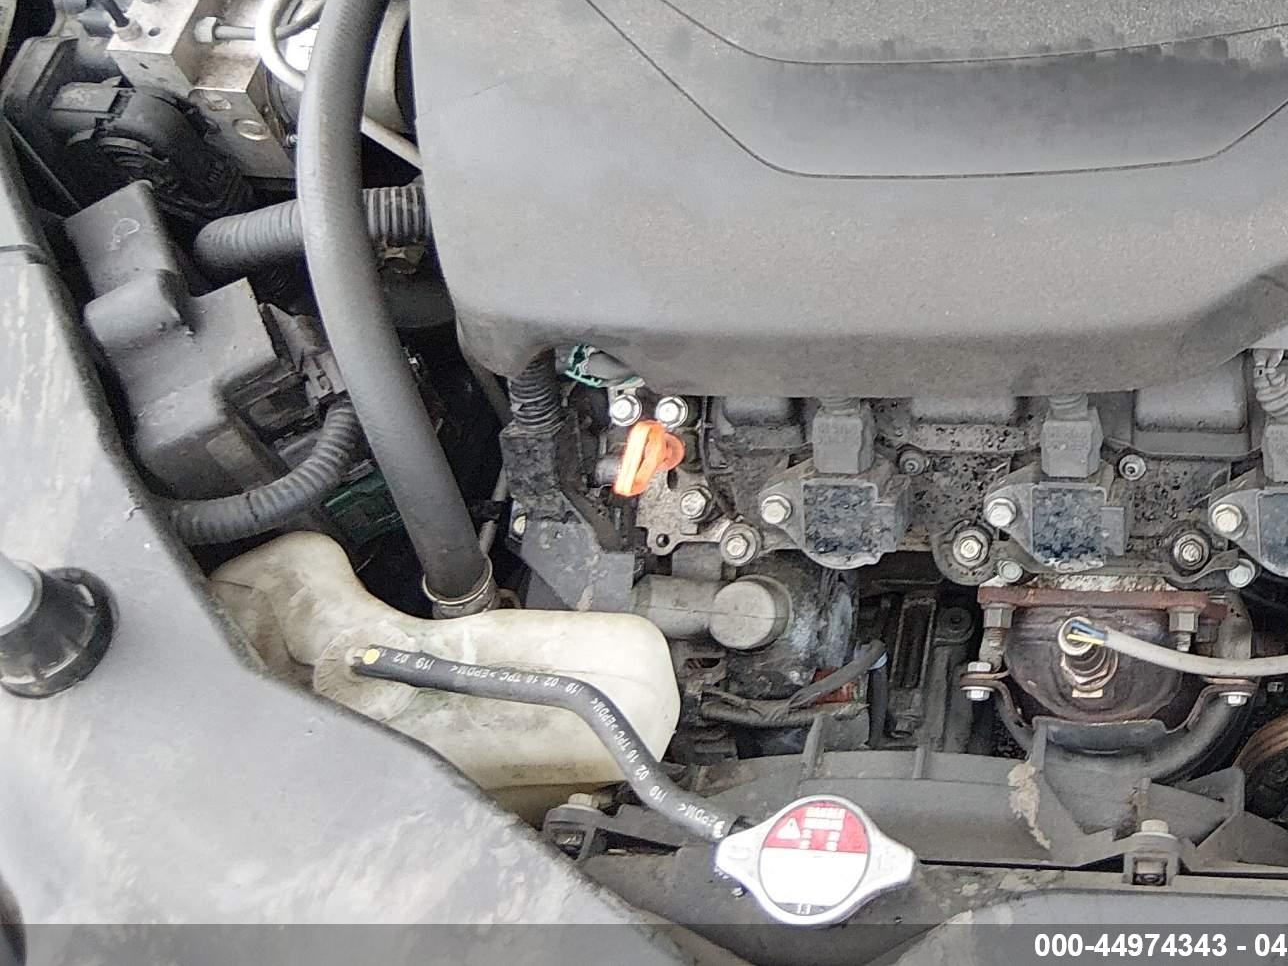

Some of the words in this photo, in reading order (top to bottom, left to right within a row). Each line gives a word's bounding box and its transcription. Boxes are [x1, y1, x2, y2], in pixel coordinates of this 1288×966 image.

[392, 652, 410, 664] 02
[499, 673, 522, 683] TPC
[543, 676, 560, 687] 02
[614, 731, 632, 752] TPC
[635, 764, 650, 780] 02
